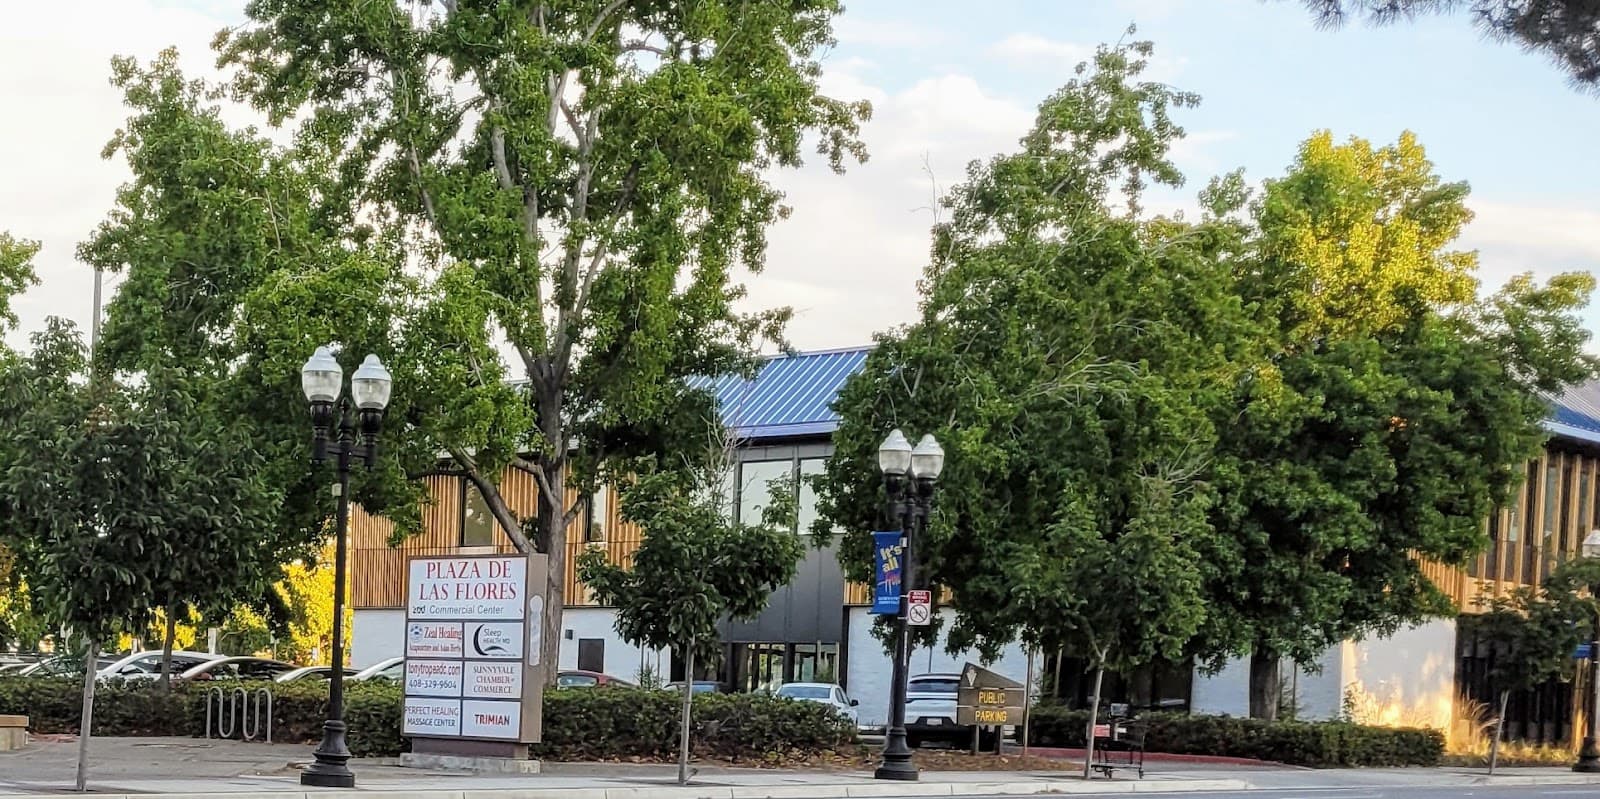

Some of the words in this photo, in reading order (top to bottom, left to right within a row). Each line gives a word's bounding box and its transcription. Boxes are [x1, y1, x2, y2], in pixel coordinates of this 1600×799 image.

[426, 561, 481, 579] PLAZA
[489, 560, 512, 578] DE
[882, 556, 899, 573] all
[419, 583, 449, 600] LAS
[455, 582, 516, 600] FLORES
[429, 604, 475, 615] Commercial
[477, 604, 504, 615] Center
[423, 626, 438, 639] Zeal
[439, 626, 463, 640] Healing
[483, 628, 502, 637] Sleep
[473, 665, 515, 674] SUNNYVALE
[476, 675, 511, 684] CHAMBER
[473, 685, 513, 694] COMMERCE
[978, 690, 1006, 704] PUBLIC
[405, 705, 431, 715] PERFECT
[431, 706, 459, 716] HEALING
[975, 710, 1008, 722] PARKING
[407, 717, 433, 727] MASSAGE
[433, 718, 456, 727] CENTER
[474, 714, 511, 726] TRIMIAN
